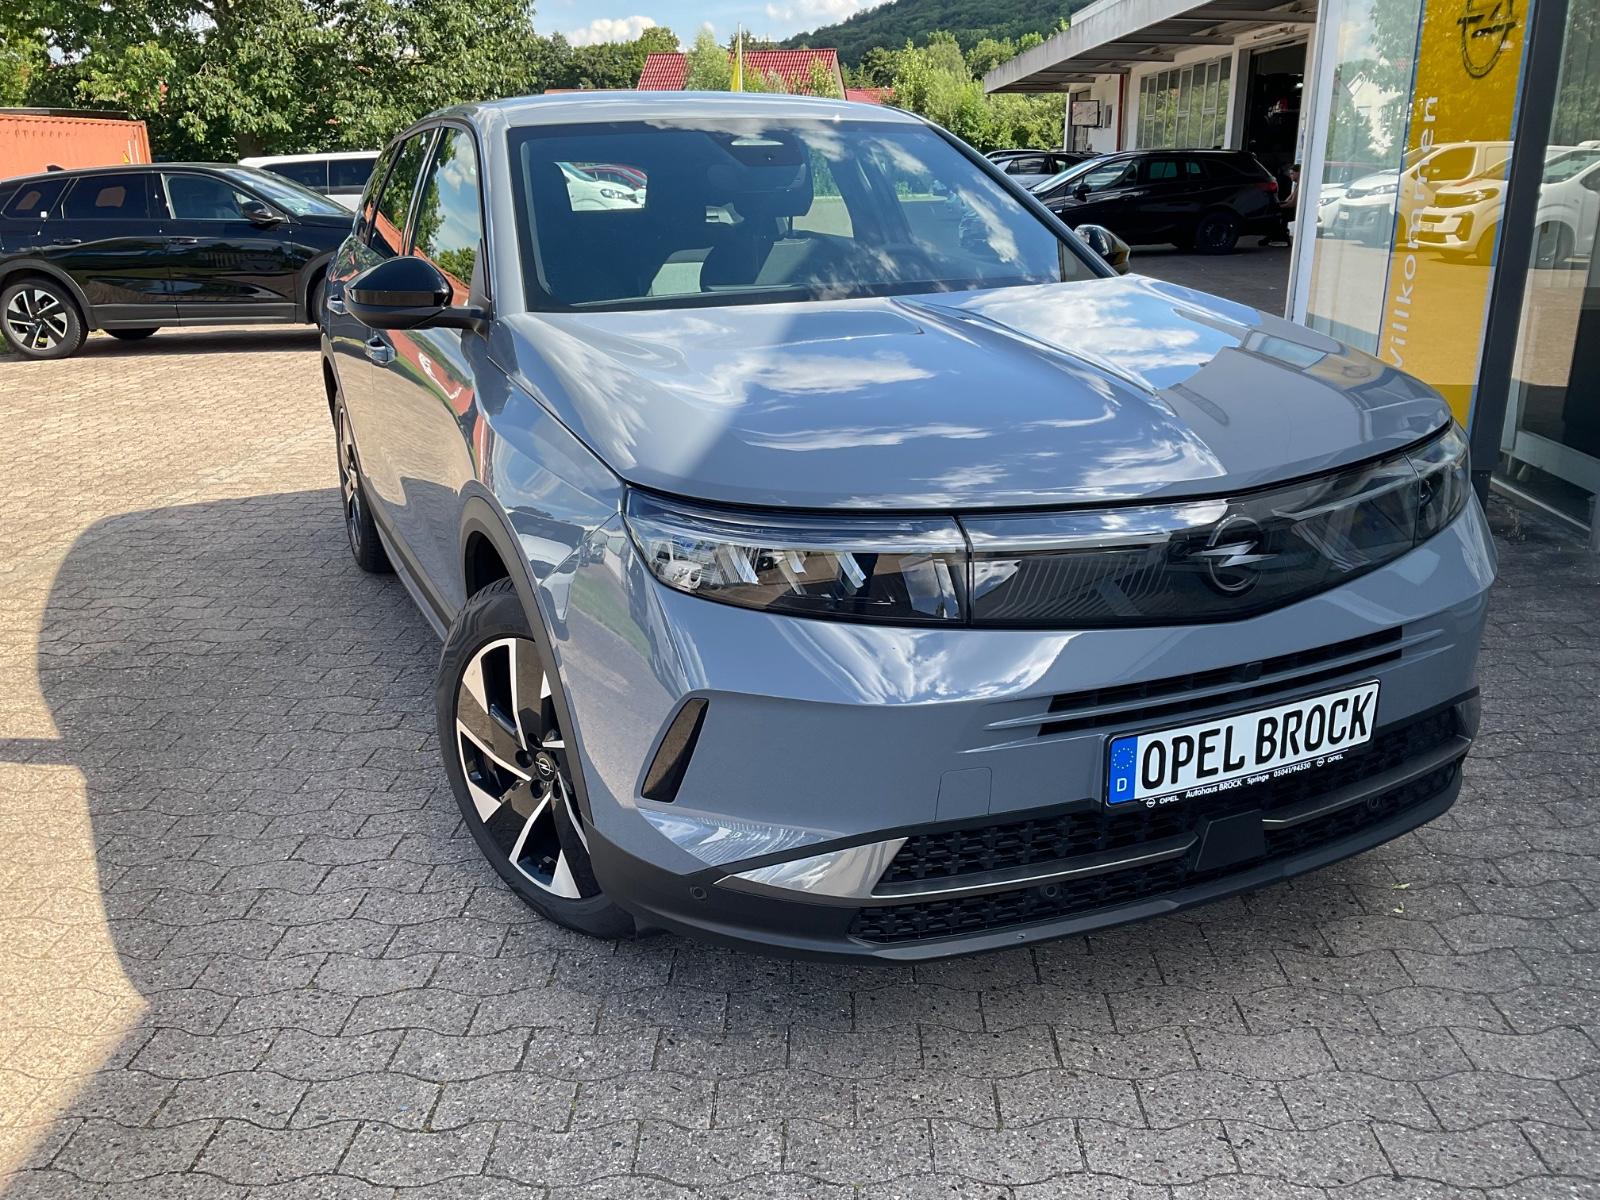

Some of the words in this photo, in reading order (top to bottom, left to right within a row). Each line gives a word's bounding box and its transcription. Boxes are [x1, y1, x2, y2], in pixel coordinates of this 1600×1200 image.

[1141, 725, 1246, 790] OPEL
[1255, 691, 1374, 765] BROCK
[1116, 777, 1128, 792] D
[1159, 795, 1179, 804] OPEL
[1185, 786, 1218, 799] Autohaus
[1218, 779, 1243, 791] BROCK
[1246, 774, 1270, 786] Springe
[1327, 753, 1344, 763] OPEL
